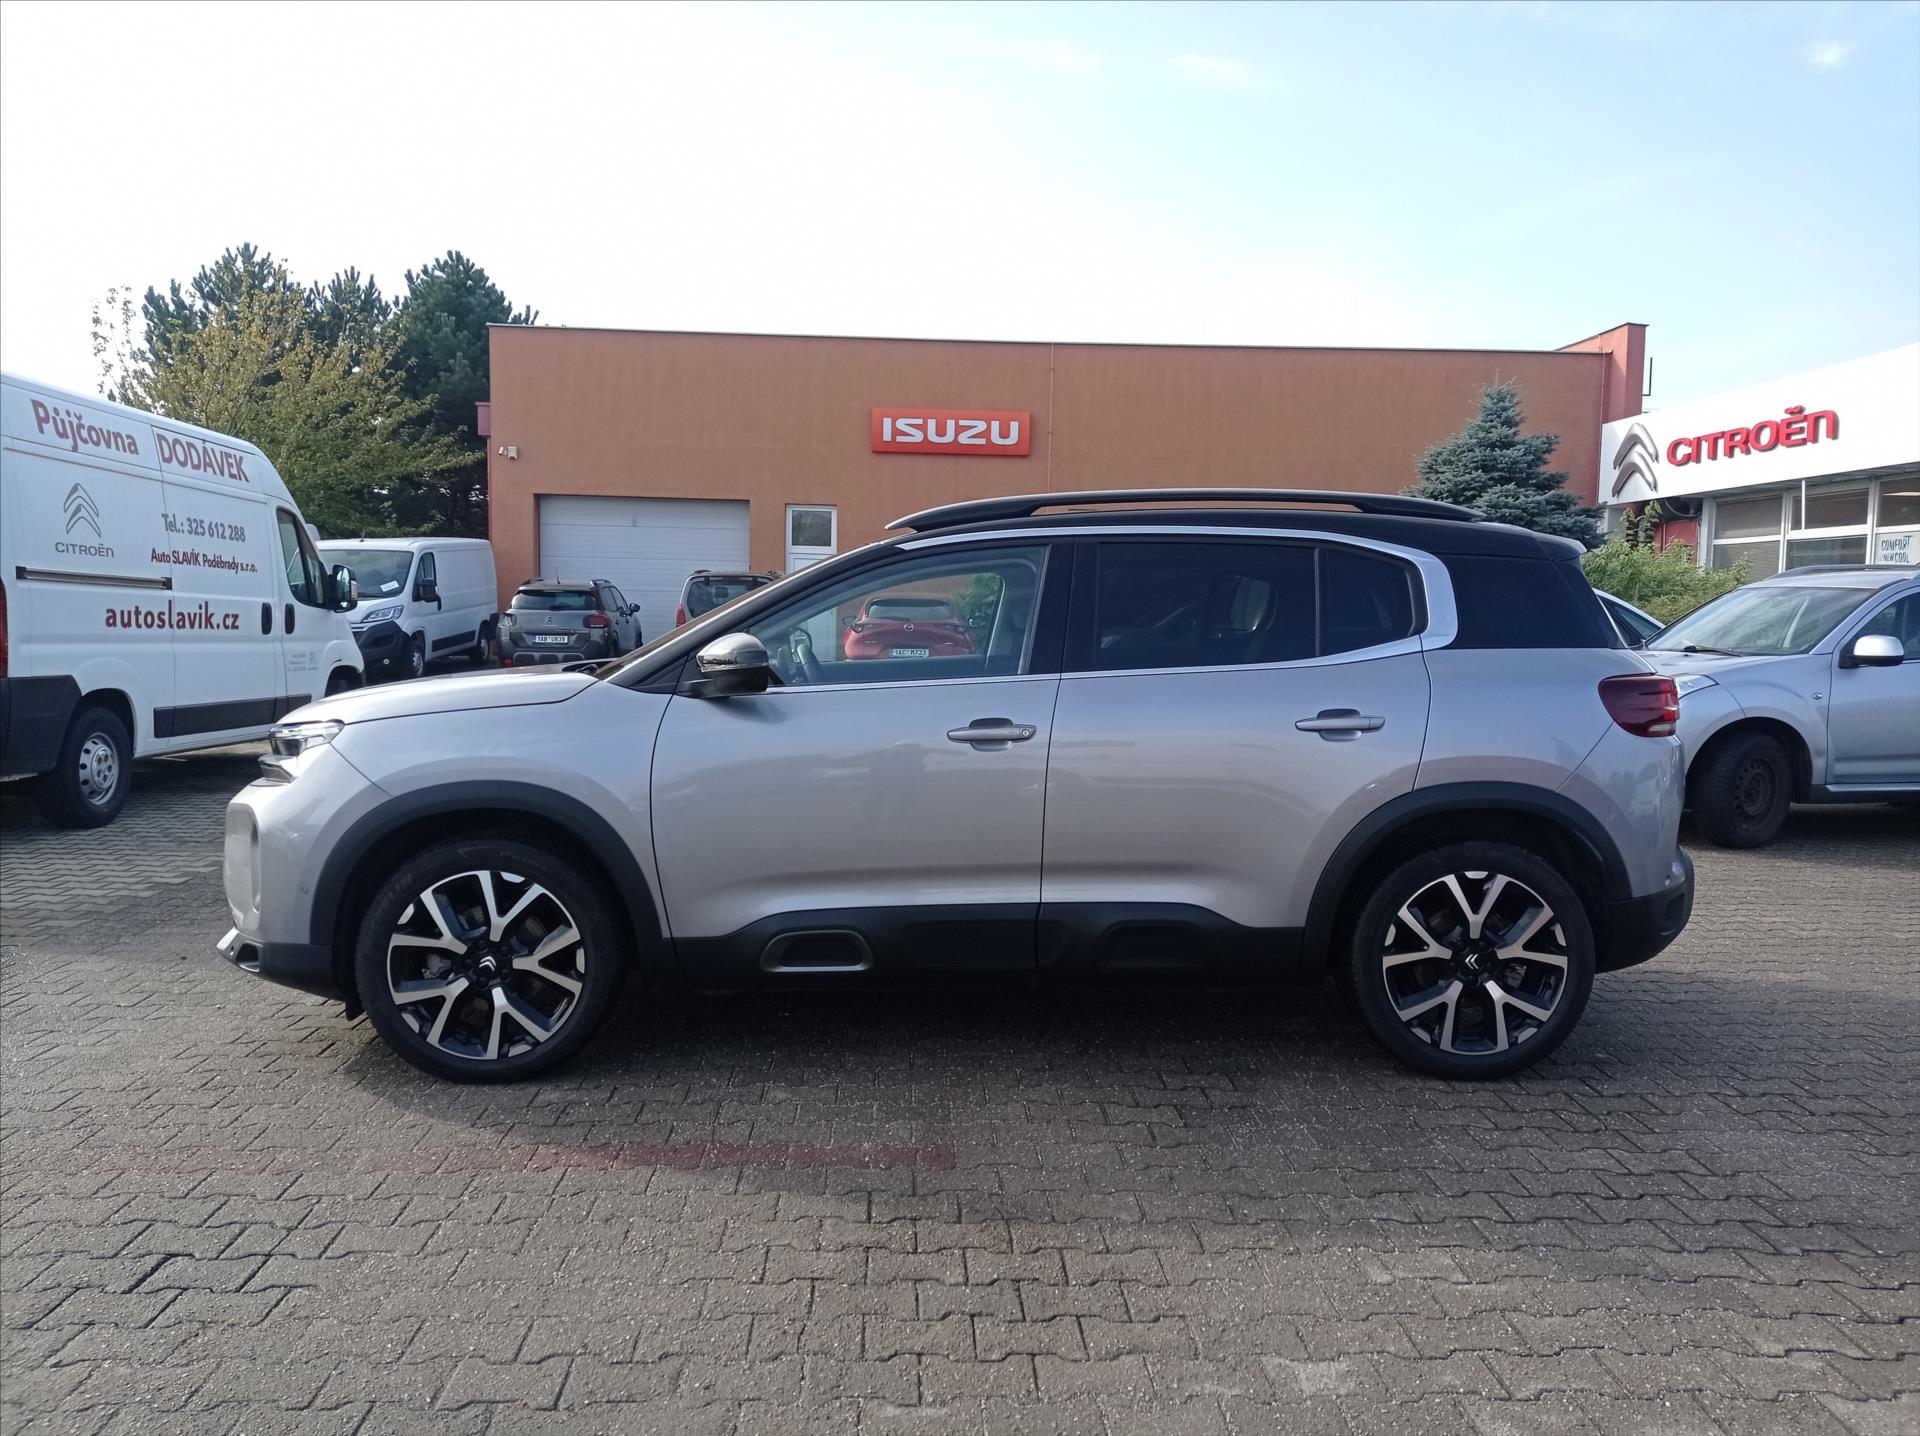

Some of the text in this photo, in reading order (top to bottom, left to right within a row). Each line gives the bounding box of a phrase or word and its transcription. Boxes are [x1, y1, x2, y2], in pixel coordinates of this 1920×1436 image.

[31, 399, 250, 483] Půjčovna DODÁVEK
[882, 417, 1019, 446] ISUZU
[1667, 405, 1839, 466] CITROËN
[161, 513, 246, 543] Tel.: 325 612 288
[55, 542, 115, 558] CITROËN
[1881, 535, 1912, 551] COMFORT
[150, 547, 258, 574] Auto SLAVÍK Poděbrady s.r.o.
[105, 599, 240, 630] autoslavik.cz
